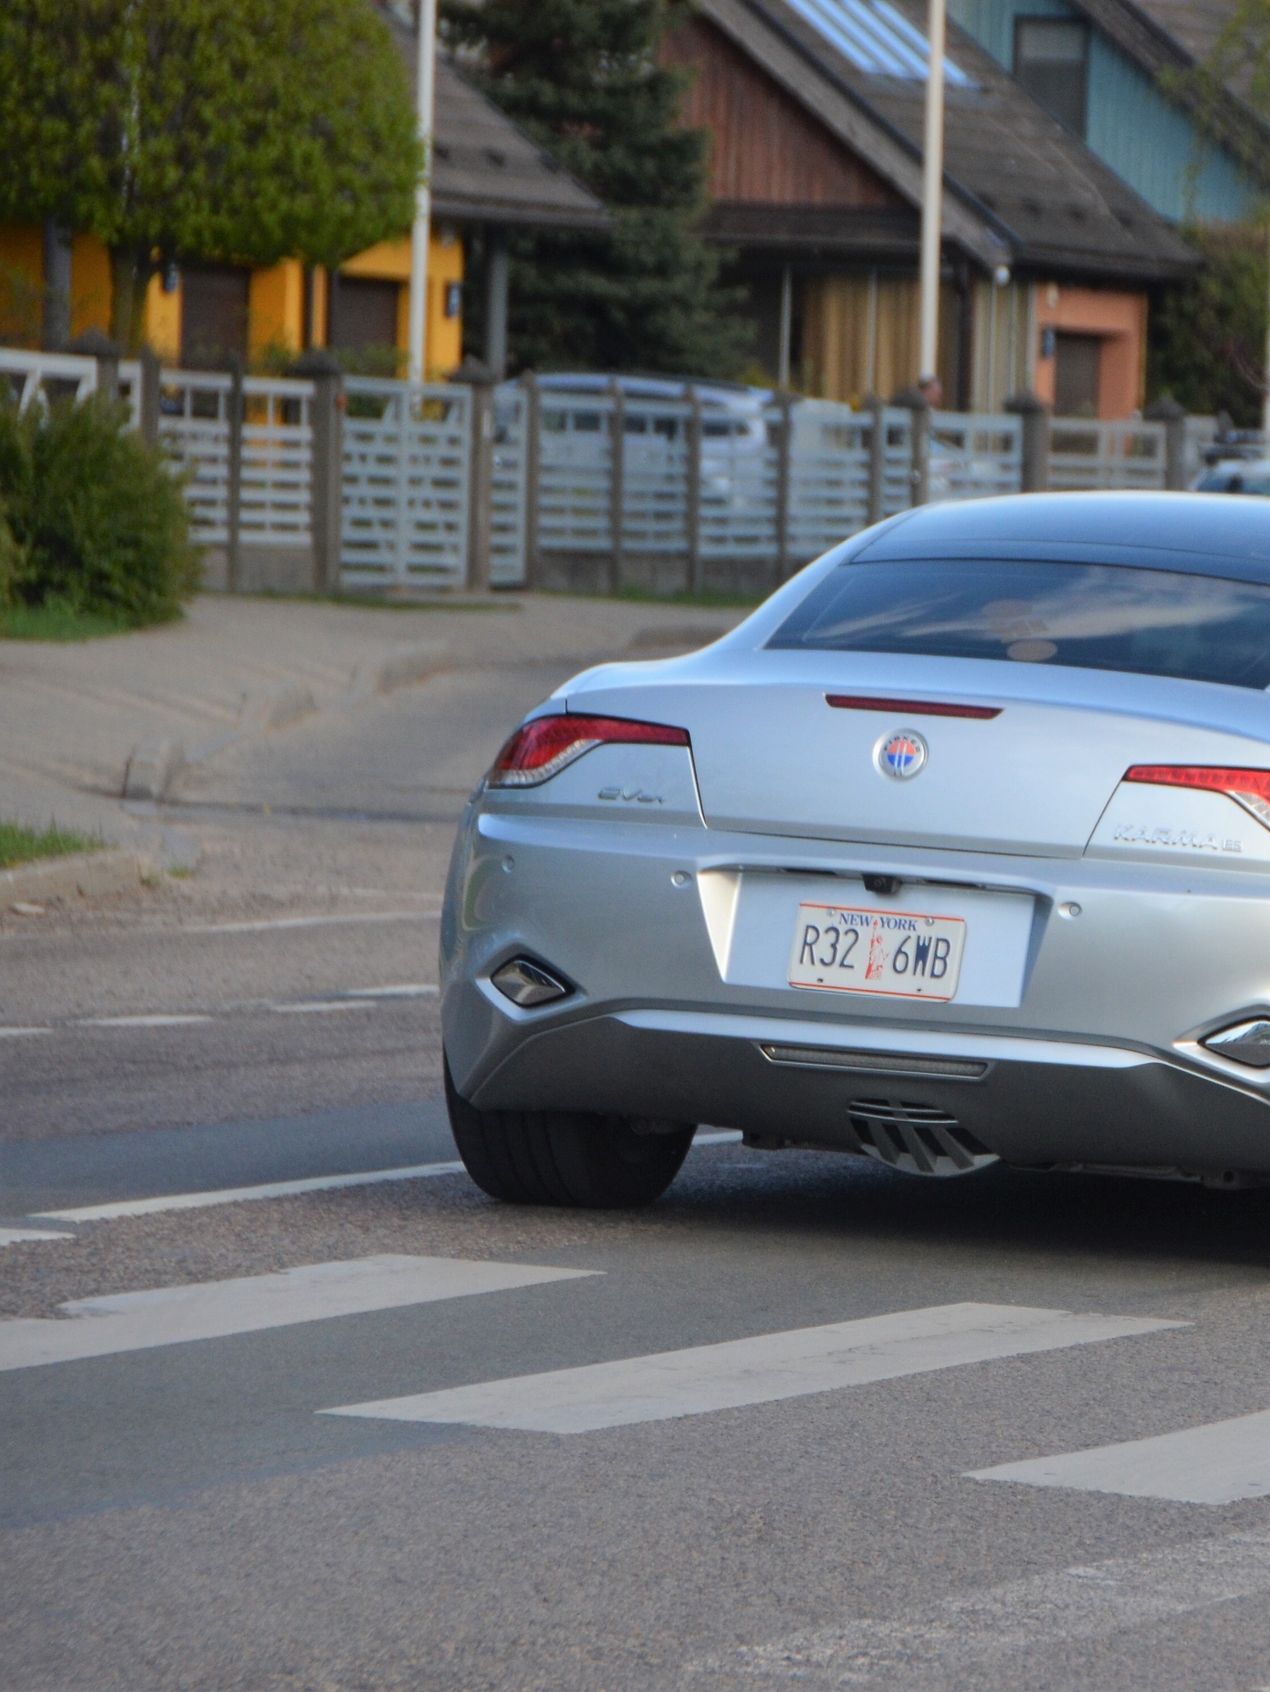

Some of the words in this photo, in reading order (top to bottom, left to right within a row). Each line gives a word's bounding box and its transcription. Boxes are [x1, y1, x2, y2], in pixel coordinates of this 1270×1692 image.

[1113, 824, 1218, 849] KARMA
[838, 912, 874, 928] NEW
[879, 916, 917, 932] YORK
[800, 925, 859, 969] R32
[892, 935, 951, 979] 6WB
